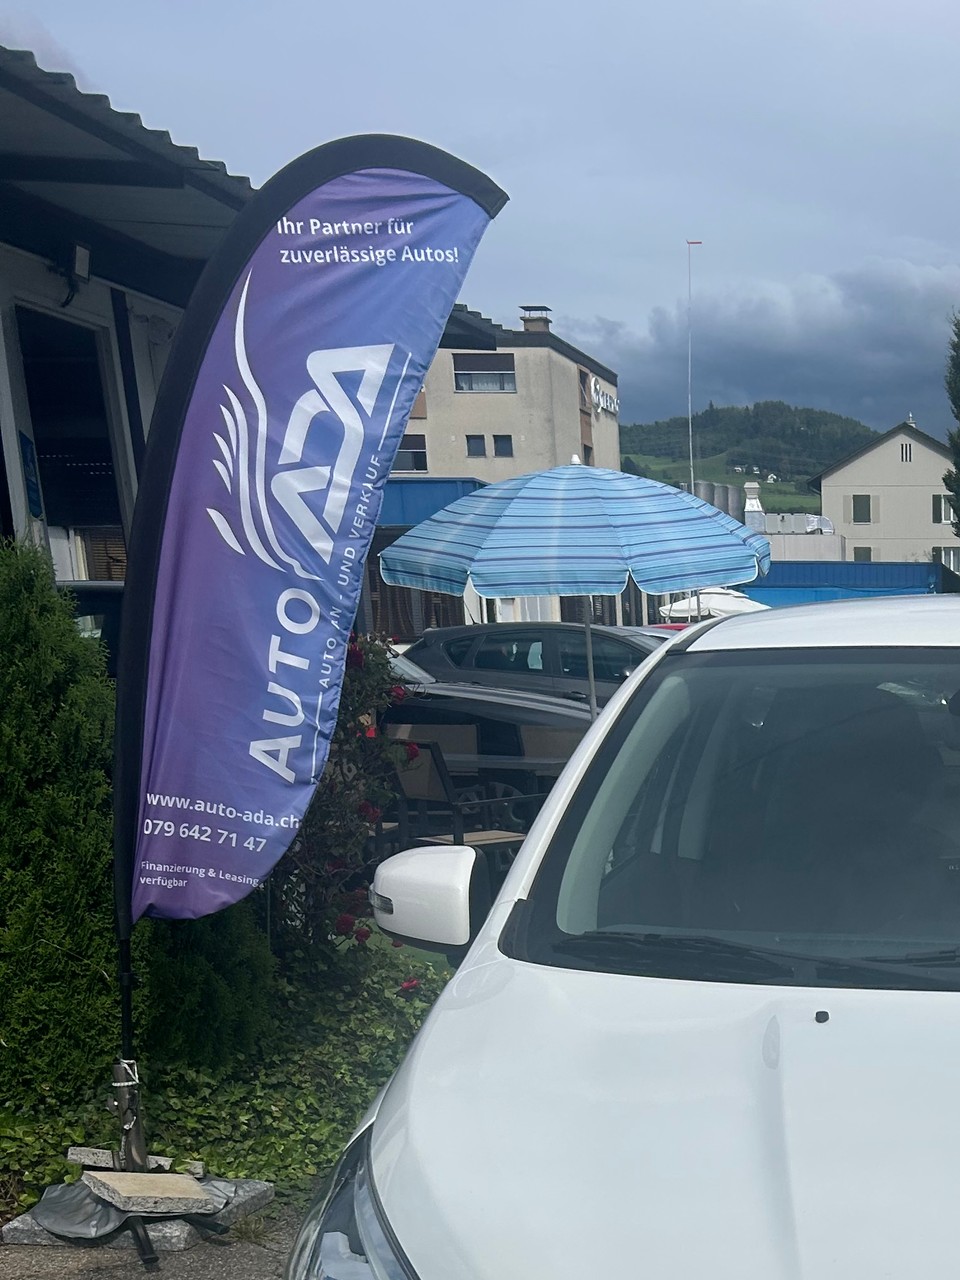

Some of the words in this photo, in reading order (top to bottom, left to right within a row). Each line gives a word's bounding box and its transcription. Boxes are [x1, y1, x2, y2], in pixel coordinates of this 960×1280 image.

[276, 216, 304, 234] Ihr
[310, 218, 382, 235] Partner
[387, 218, 414, 234] für
[280, 245, 397, 266] zuverlässige
[401, 246, 458, 263] Autos!
[270, 342, 396, 566] ADA
[319, 637, 338, 689] AUTO
[337, 547, 357, 587] UND
[348, 454, 381, 539] VERKAUF
[249, 586, 322, 784] AUTO
[146, 792, 299, 829] www.auto-ada.ch
[143, 818, 175, 837] 079
[179, 823, 212, 842] 642
[217, 829, 238, 847] 71
[243, 836, 267, 852] 47
[140, 876, 188, 889] verfügbar
[141, 861, 206, 878] Finanzierung
[207, 868, 217, 878] &
[219, 869, 260, 888] Leasing
